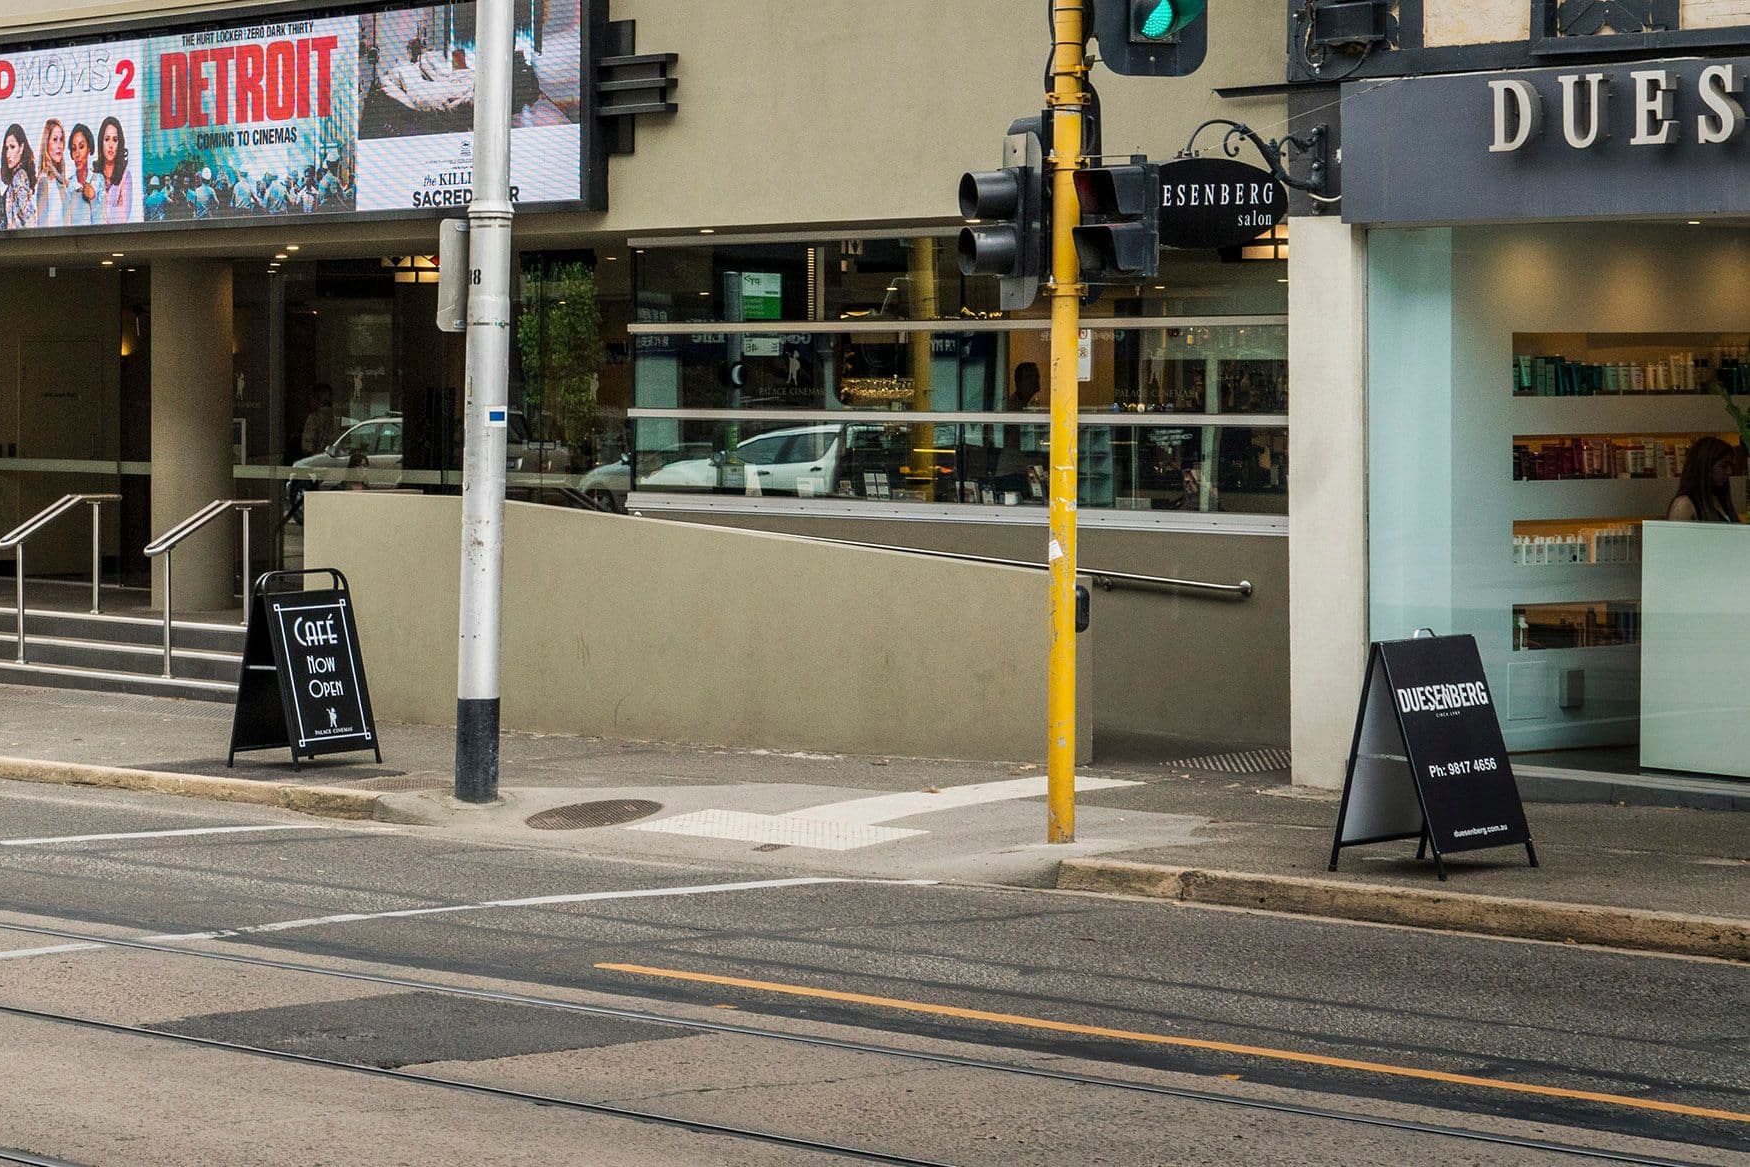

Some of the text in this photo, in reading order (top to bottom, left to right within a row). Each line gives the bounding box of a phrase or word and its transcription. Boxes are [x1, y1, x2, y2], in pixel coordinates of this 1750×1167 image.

[182, 22, 314, 47] THE HURT LOCKER ZERO DARK THIRTY
[15, 48, 112, 99] MOMS
[114, 59, 135, 100] 2
[160, 35, 338, 130] DETROIT
[197, 126, 297, 150] COMING TO CINEMAS
[423, 172, 472, 187] the KILLI
[413, 188, 473, 208] SACRED
[1162, 183, 1274, 207] ESENBERG
[1237, 210, 1272, 226] salon
[294, 613, 338, 647] CAFÉ
[306, 655, 336, 674] NOW
[309, 679, 344, 698] OPEN
[1397, 681, 1489, 712] DUESENBERG
[1429, 757, 1497, 778] Ph: 9817 4656
[1454, 823, 1508, 838] duesenberg.com.au
